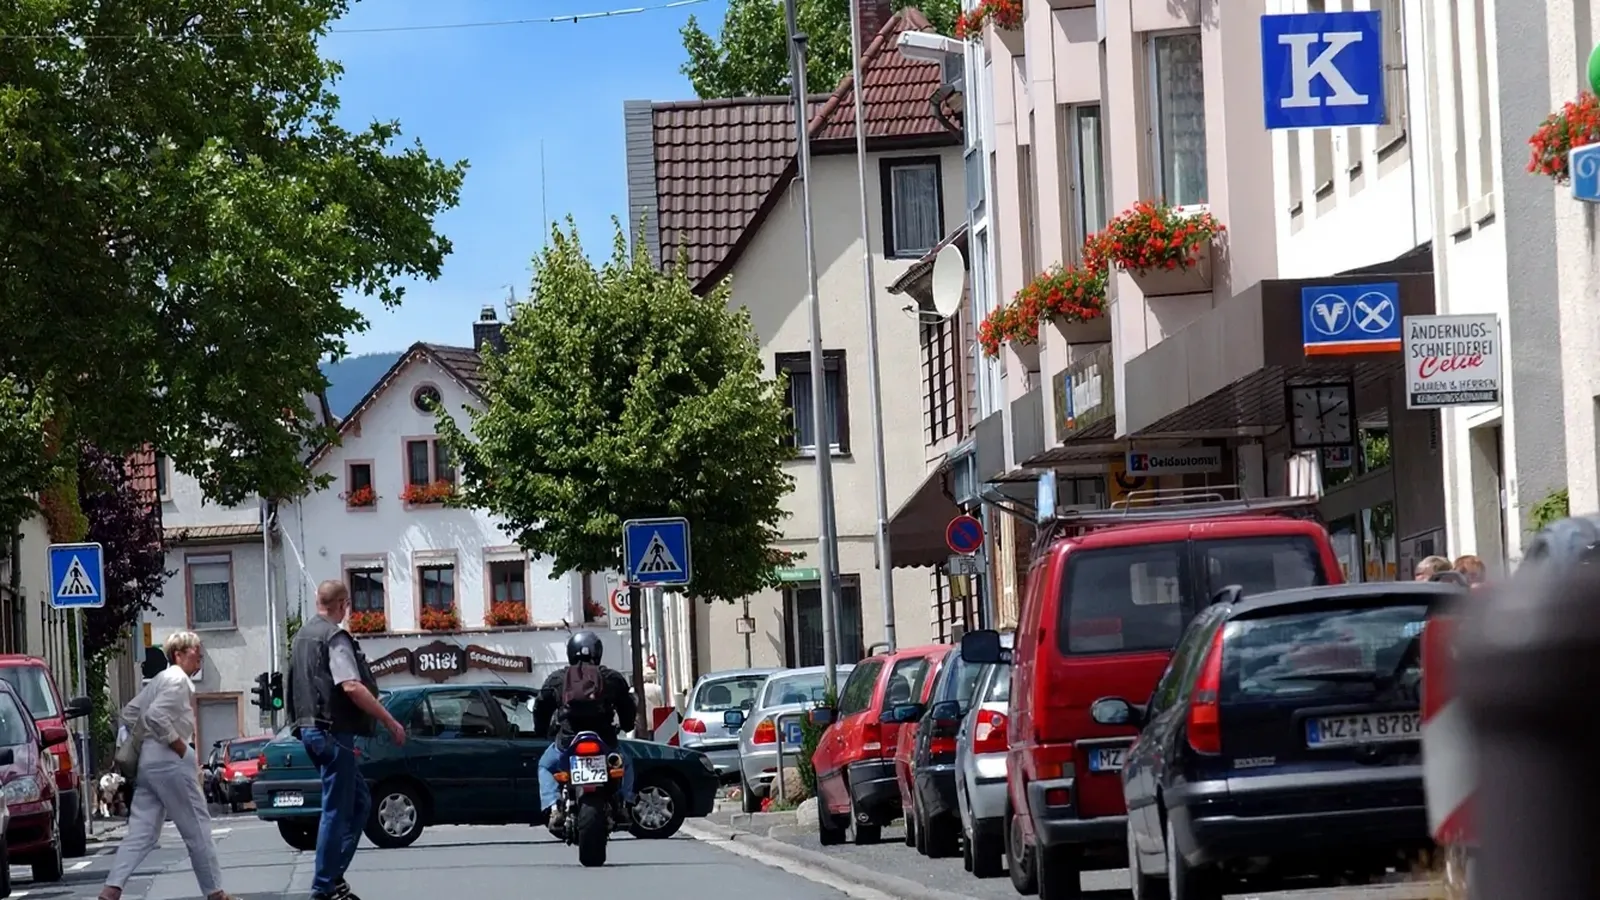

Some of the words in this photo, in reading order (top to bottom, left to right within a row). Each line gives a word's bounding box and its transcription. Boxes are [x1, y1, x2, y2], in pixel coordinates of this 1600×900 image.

[1278, 31, 1368, 108] K
[1411, 340, 1493, 359] SCHNEIDEREI
[1320, 718, 1347, 739] MZ
[1361, 716, 1372, 735] A
[1100, 749, 1122, 767] MZ
[573, 770, 590, 782] GL
